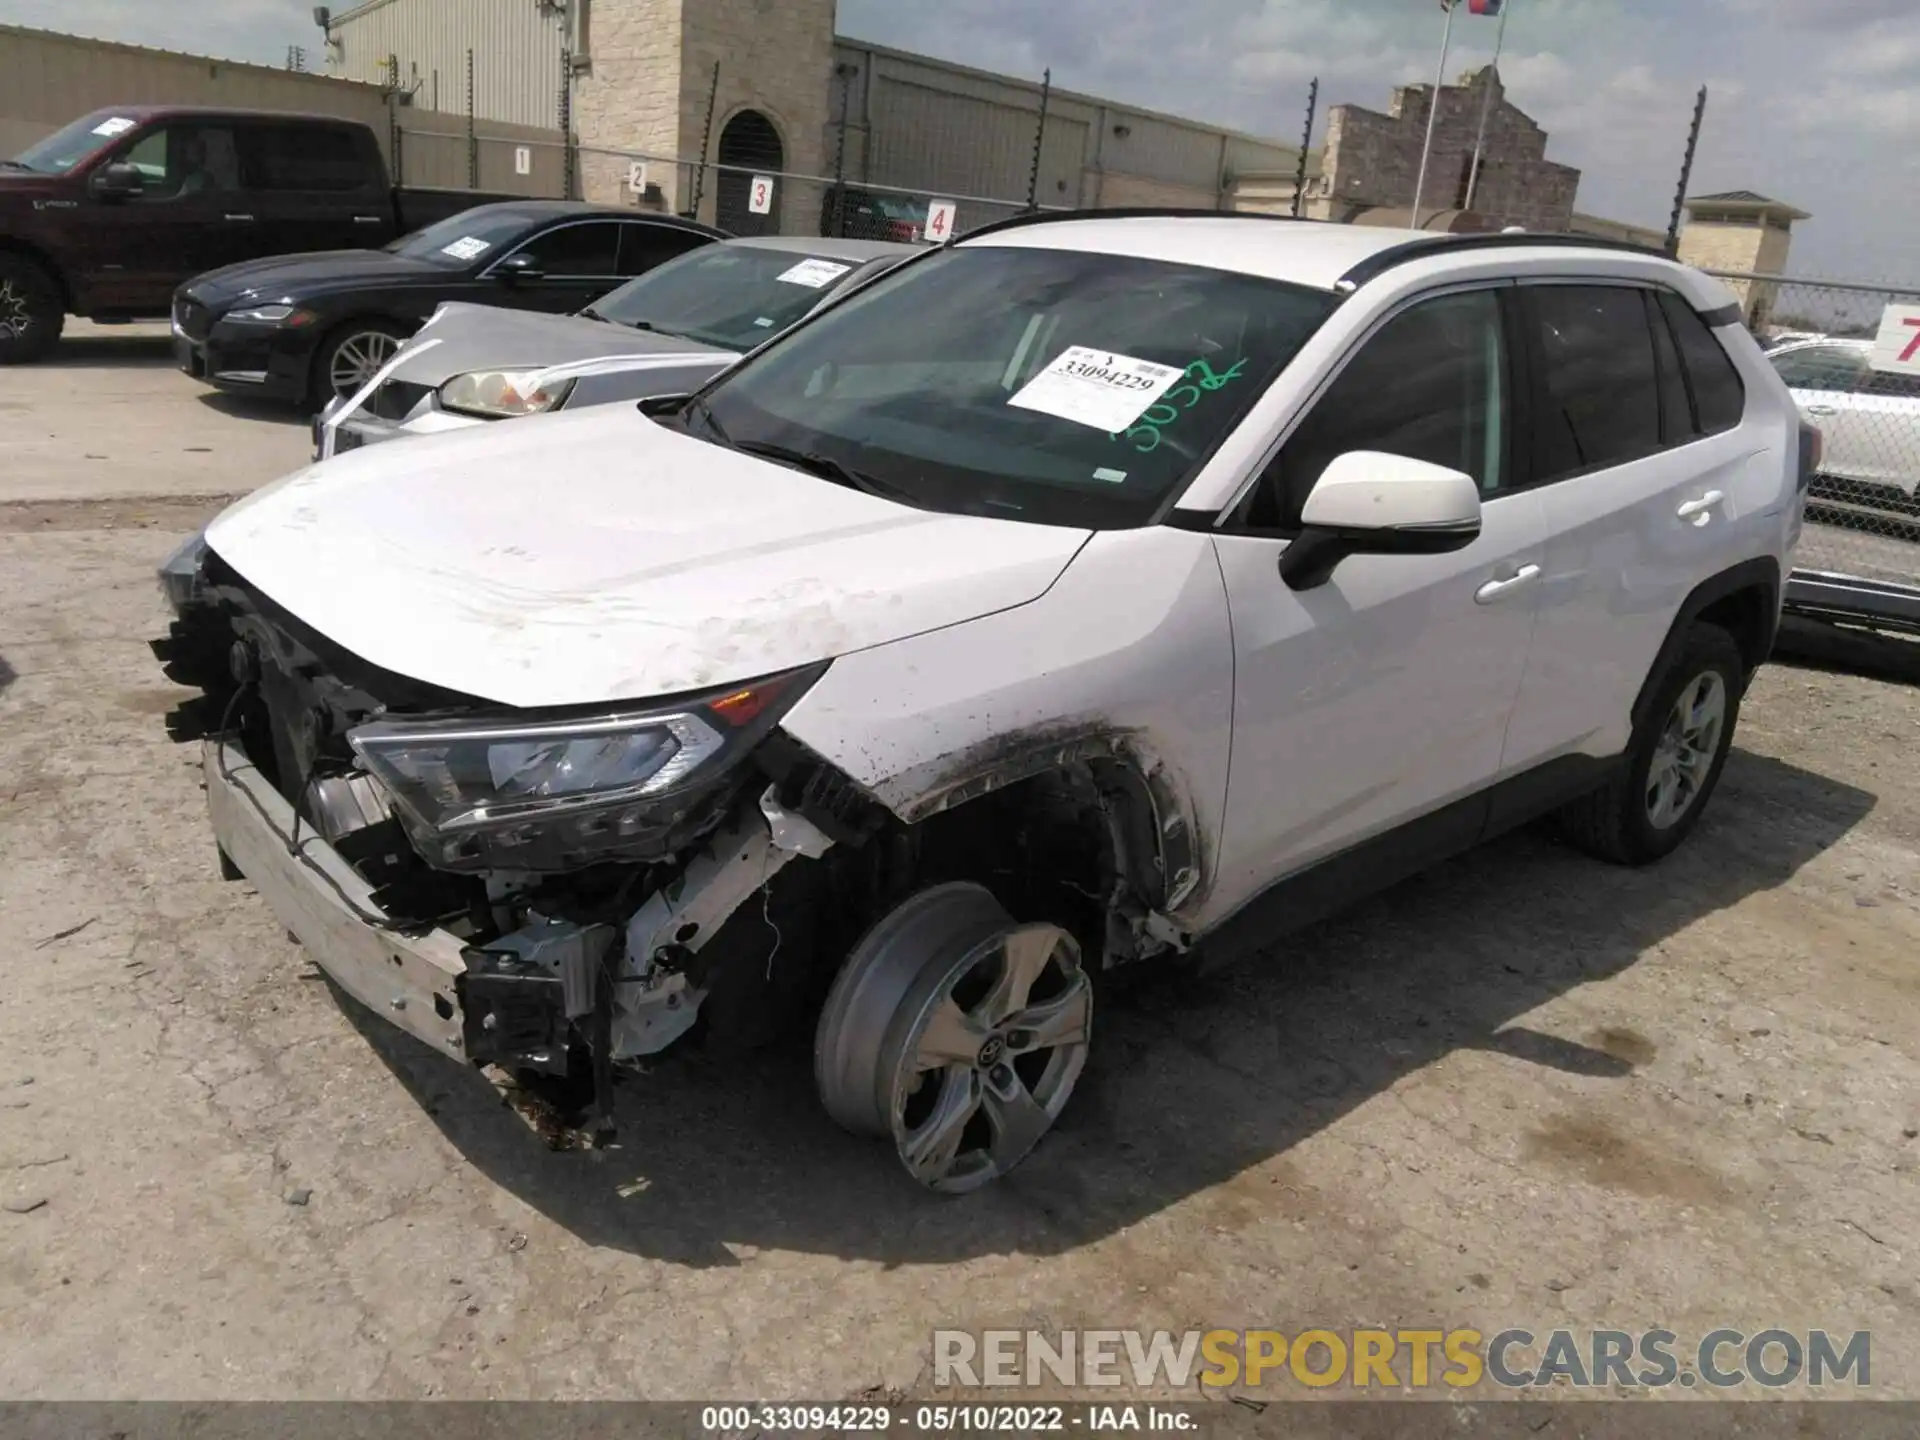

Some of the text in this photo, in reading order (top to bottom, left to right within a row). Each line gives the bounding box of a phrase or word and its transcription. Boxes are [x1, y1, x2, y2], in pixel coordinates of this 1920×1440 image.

[634, 165, 643, 187] 2
[755, 183, 767, 207] 3
[931, 208, 945, 235] 4
[1896, 318, 1920, 361] 7
[1057, 360, 1156, 391] 33094229
